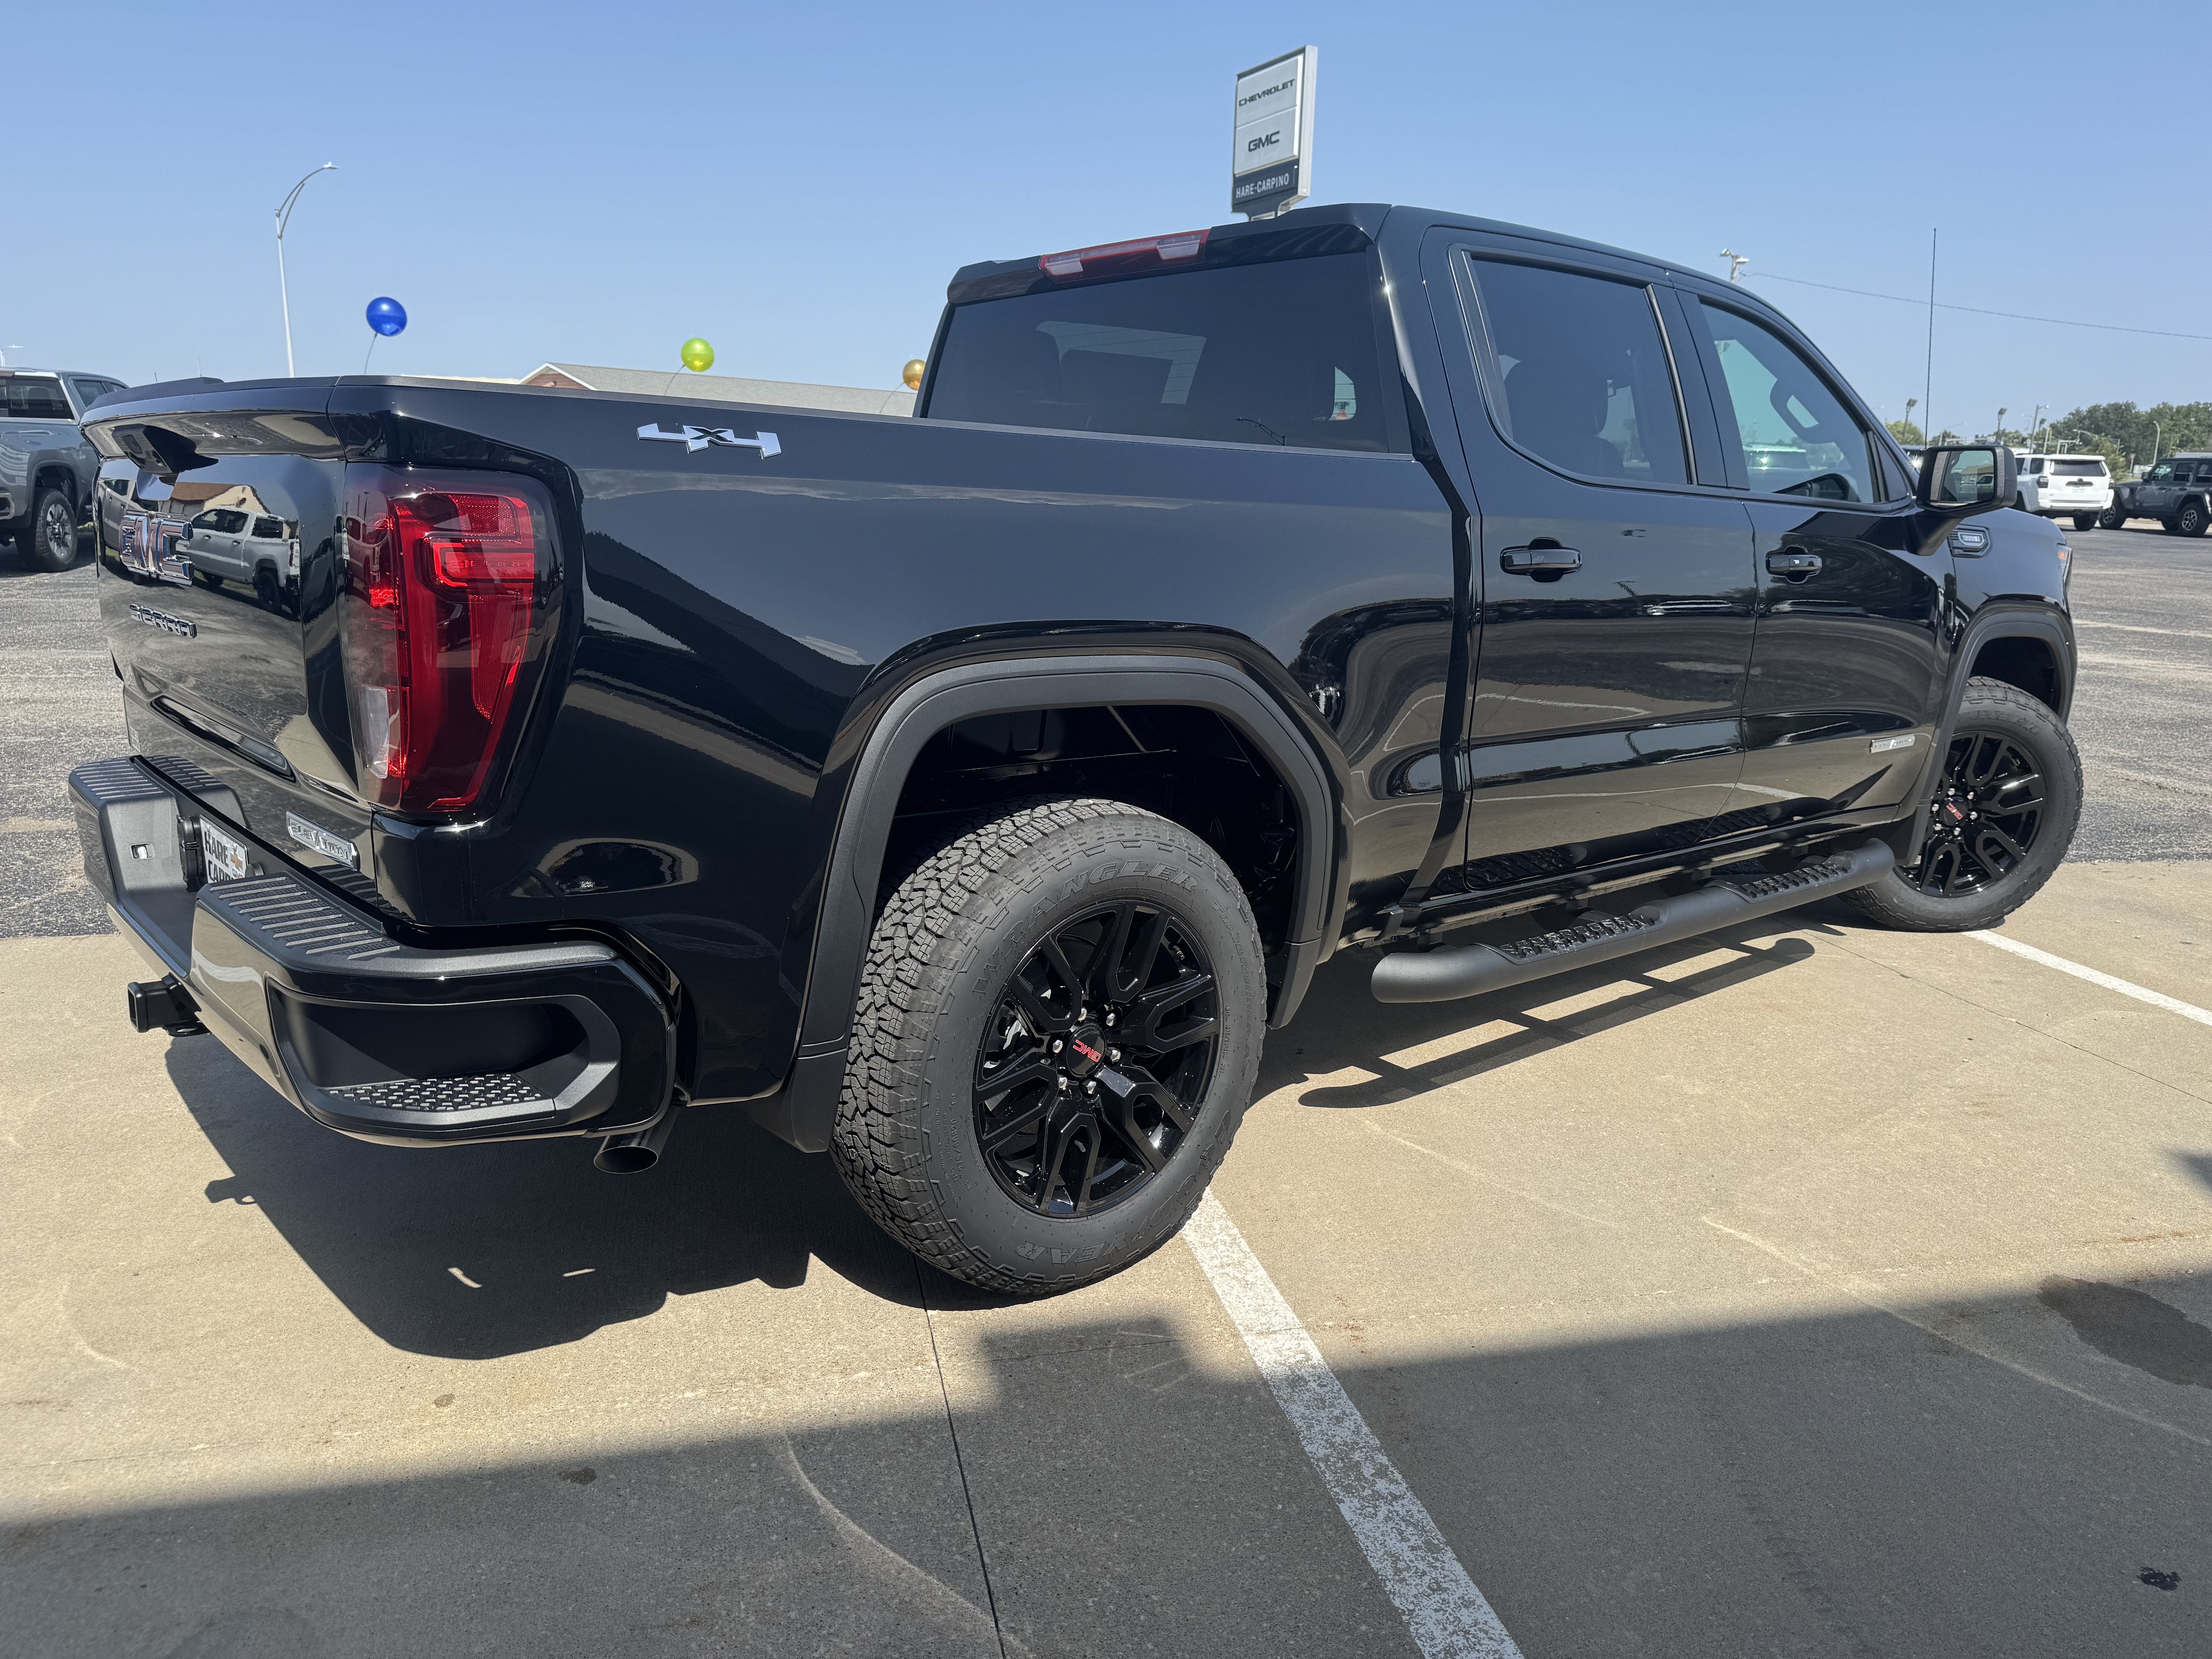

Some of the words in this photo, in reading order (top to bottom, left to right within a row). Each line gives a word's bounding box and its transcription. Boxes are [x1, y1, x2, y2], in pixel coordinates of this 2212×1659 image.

[1239, 79, 1295, 107] CHEVROLET
[1248, 131, 1279, 152] GMC
[1236, 173, 1290, 199] HARE-CARPINO
[120, 514, 194, 582] GMC
[130, 603, 197, 639] SIERRA
[204, 831, 229, 868] HARE
[972, 860, 1198, 994] WRANGLER
[1072, 1039, 1101, 1062] GMC
[1015, 1109, 1231, 1264] GOODYEAR
